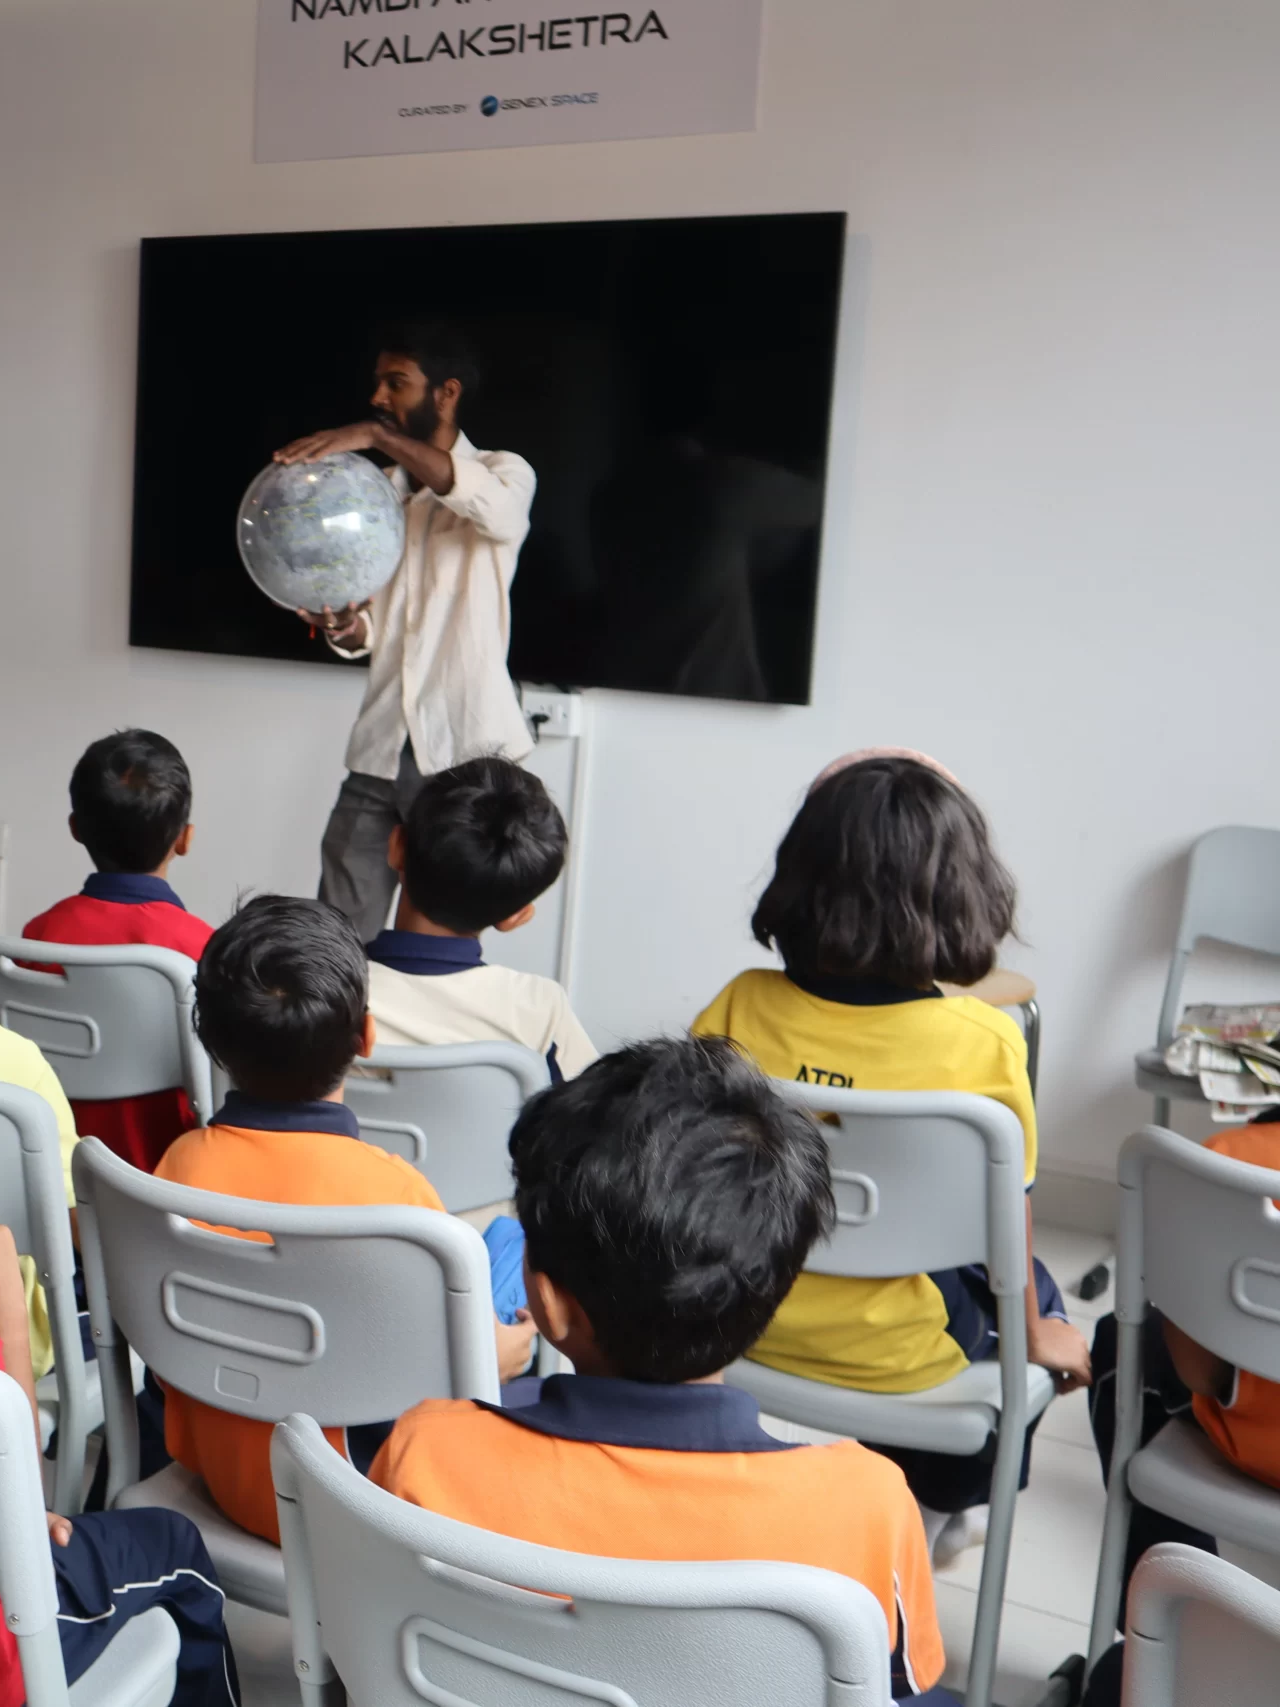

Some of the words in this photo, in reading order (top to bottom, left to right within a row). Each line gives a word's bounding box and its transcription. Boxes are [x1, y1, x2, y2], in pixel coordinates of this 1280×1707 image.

[344, 10, 669, 68] KALAKSHETRA
[398, 104, 451, 117] CURATED
[501, 97, 548, 110] GENEX
[551, 92, 599, 106] SPACE
